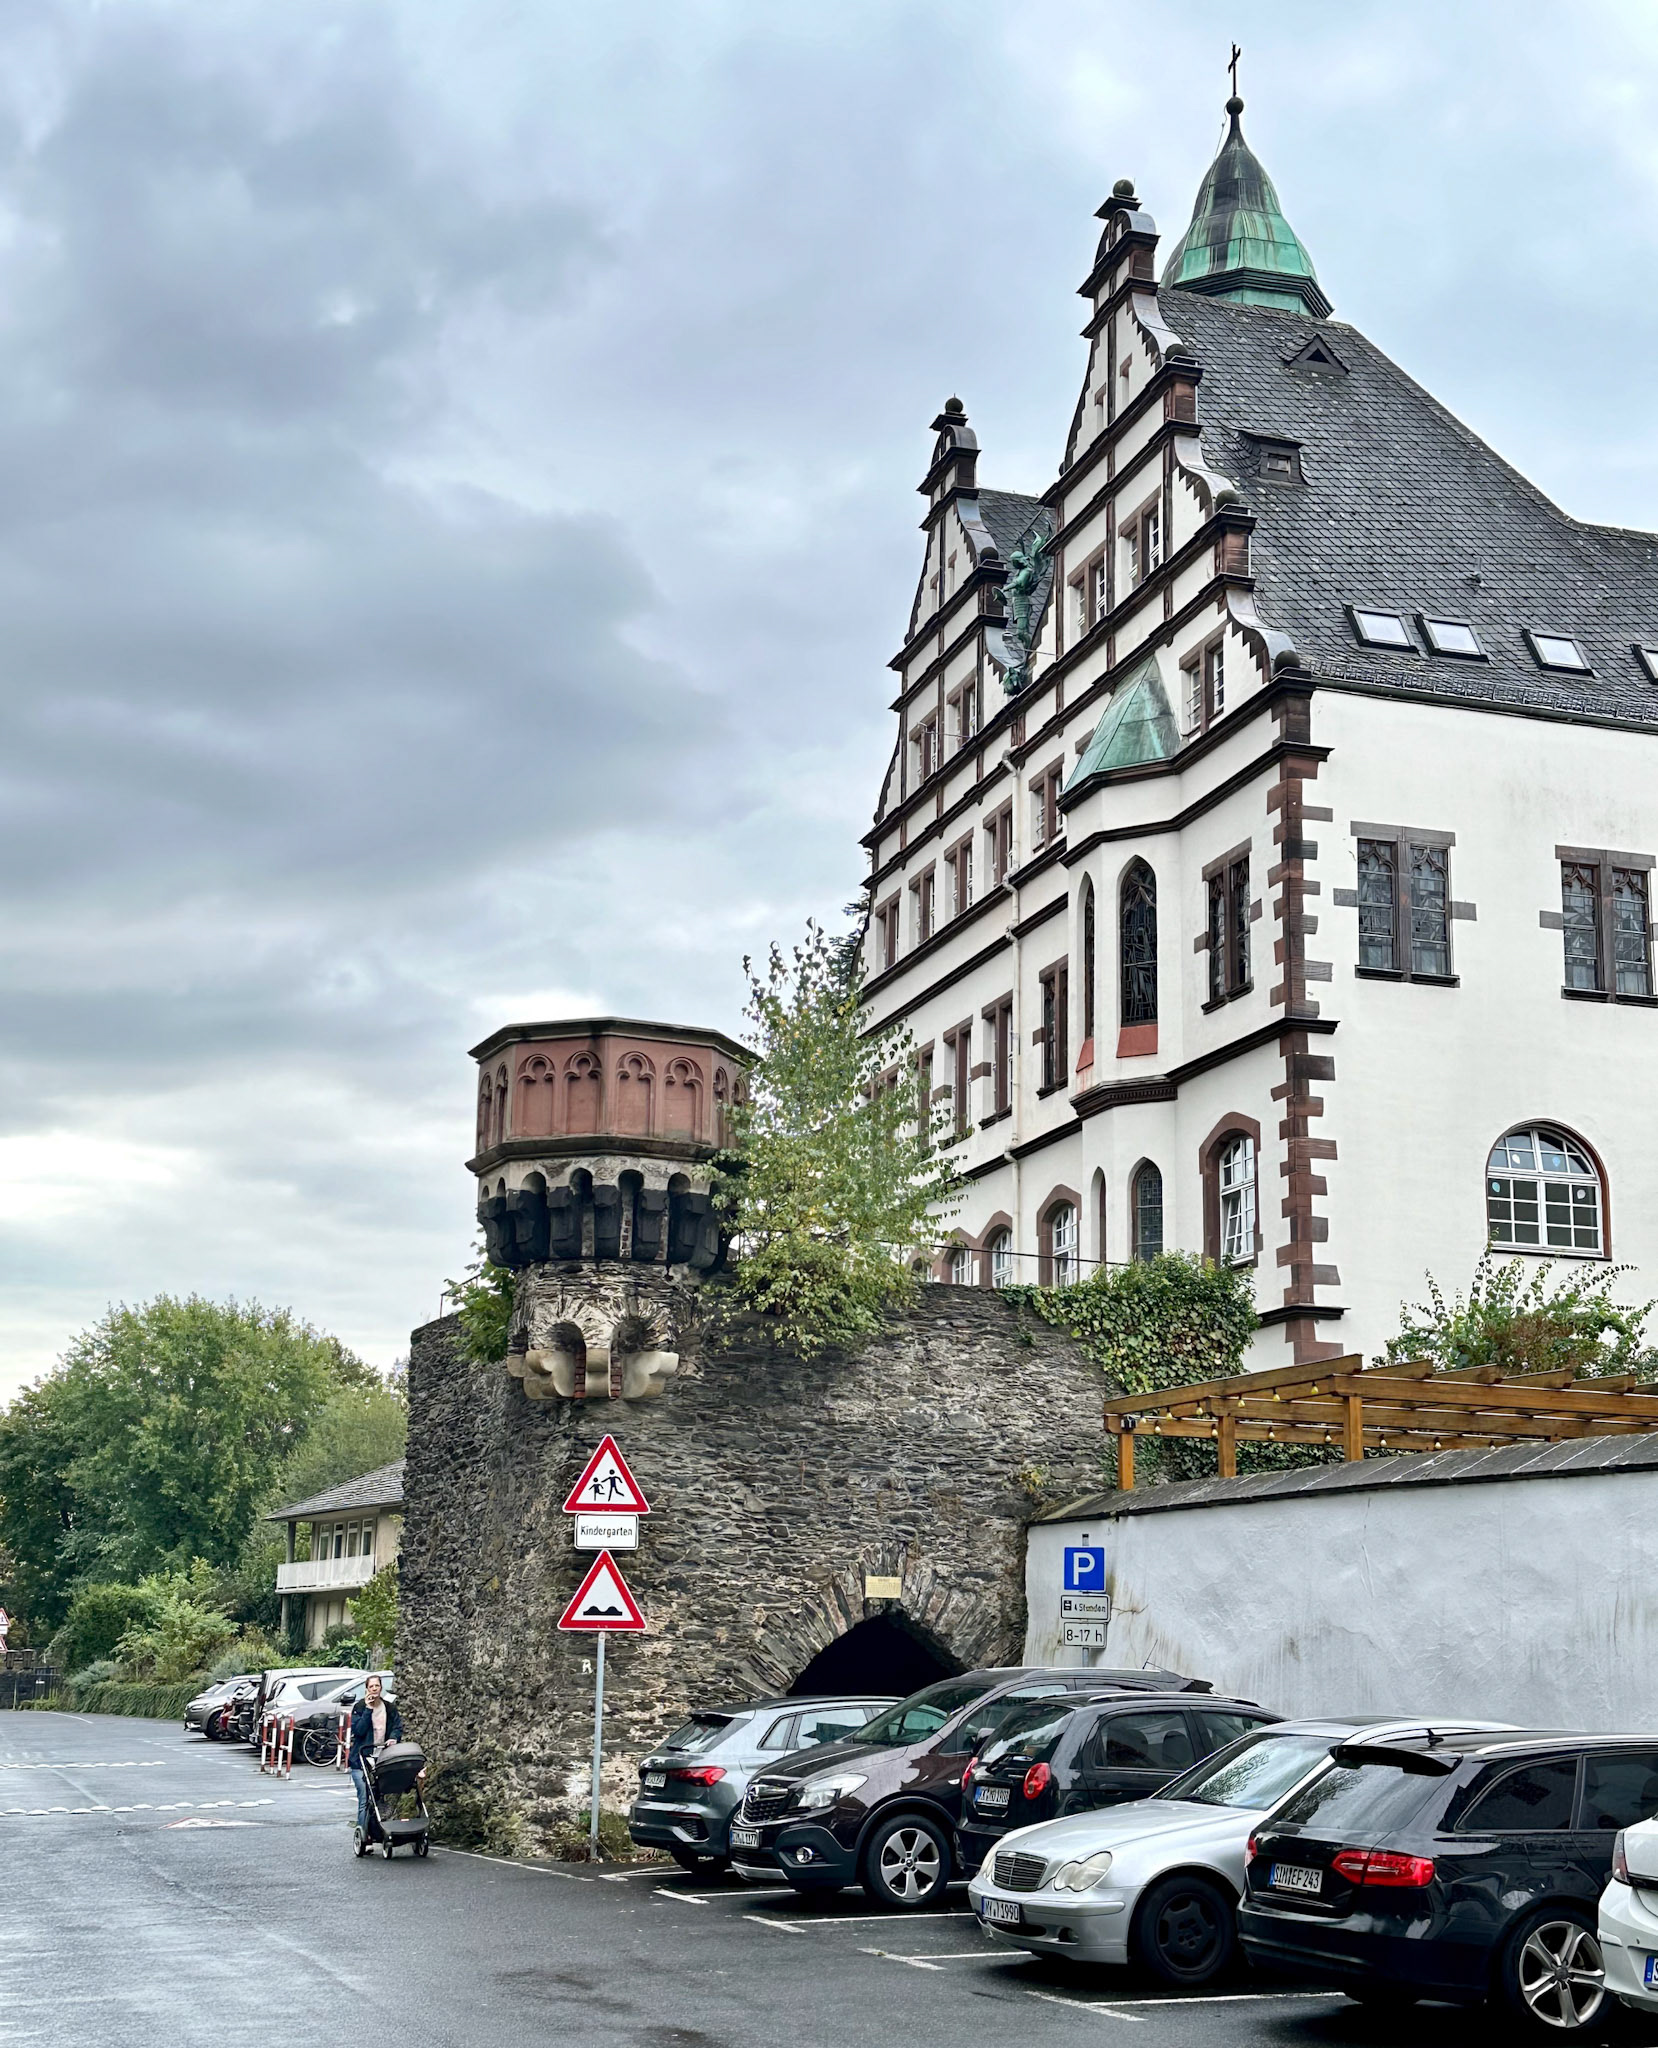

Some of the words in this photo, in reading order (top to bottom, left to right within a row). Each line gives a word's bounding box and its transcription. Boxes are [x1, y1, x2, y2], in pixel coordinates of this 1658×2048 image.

[580, 1525, 633, 1538] Kindergarten
[1073, 1552, 1095, 1586] P
[1079, 1603, 1106, 1612] Stunden
[1066, 1629, 1091, 1642] 8-17
[1095, 1629, 1103, 1643] h
